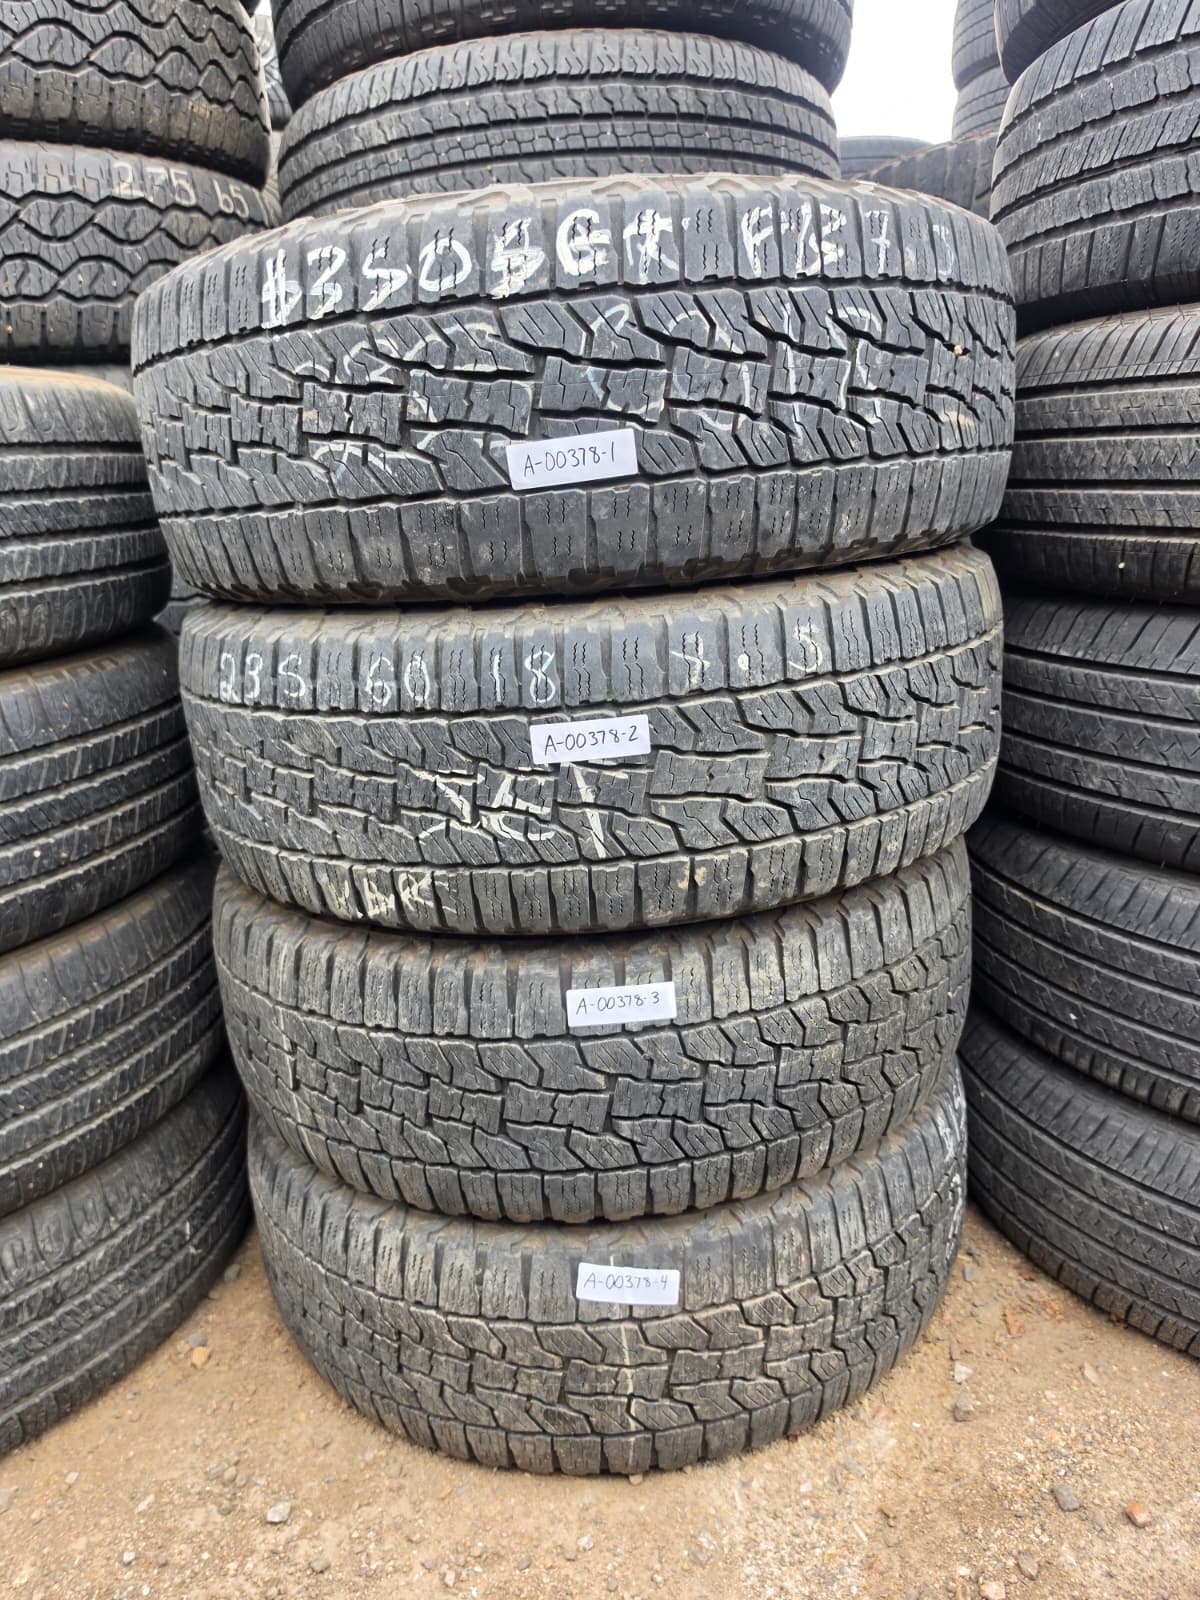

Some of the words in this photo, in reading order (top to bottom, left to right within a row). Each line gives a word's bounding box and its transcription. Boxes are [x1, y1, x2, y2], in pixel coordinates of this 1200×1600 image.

[112, 160, 197, 207] 275
[213, 178, 250, 219] 65
[522, 440, 615, 478] A-00378-1
[219, 654, 307, 701] 235
[364, 655, 431, 706] 60
[490, 650, 557, 705] 18
[543, 724, 640, 757] A-00378-2
[575, 990, 661, 1016] A-00378-3
[583, 1271, 669, 1290] A-00378-4
